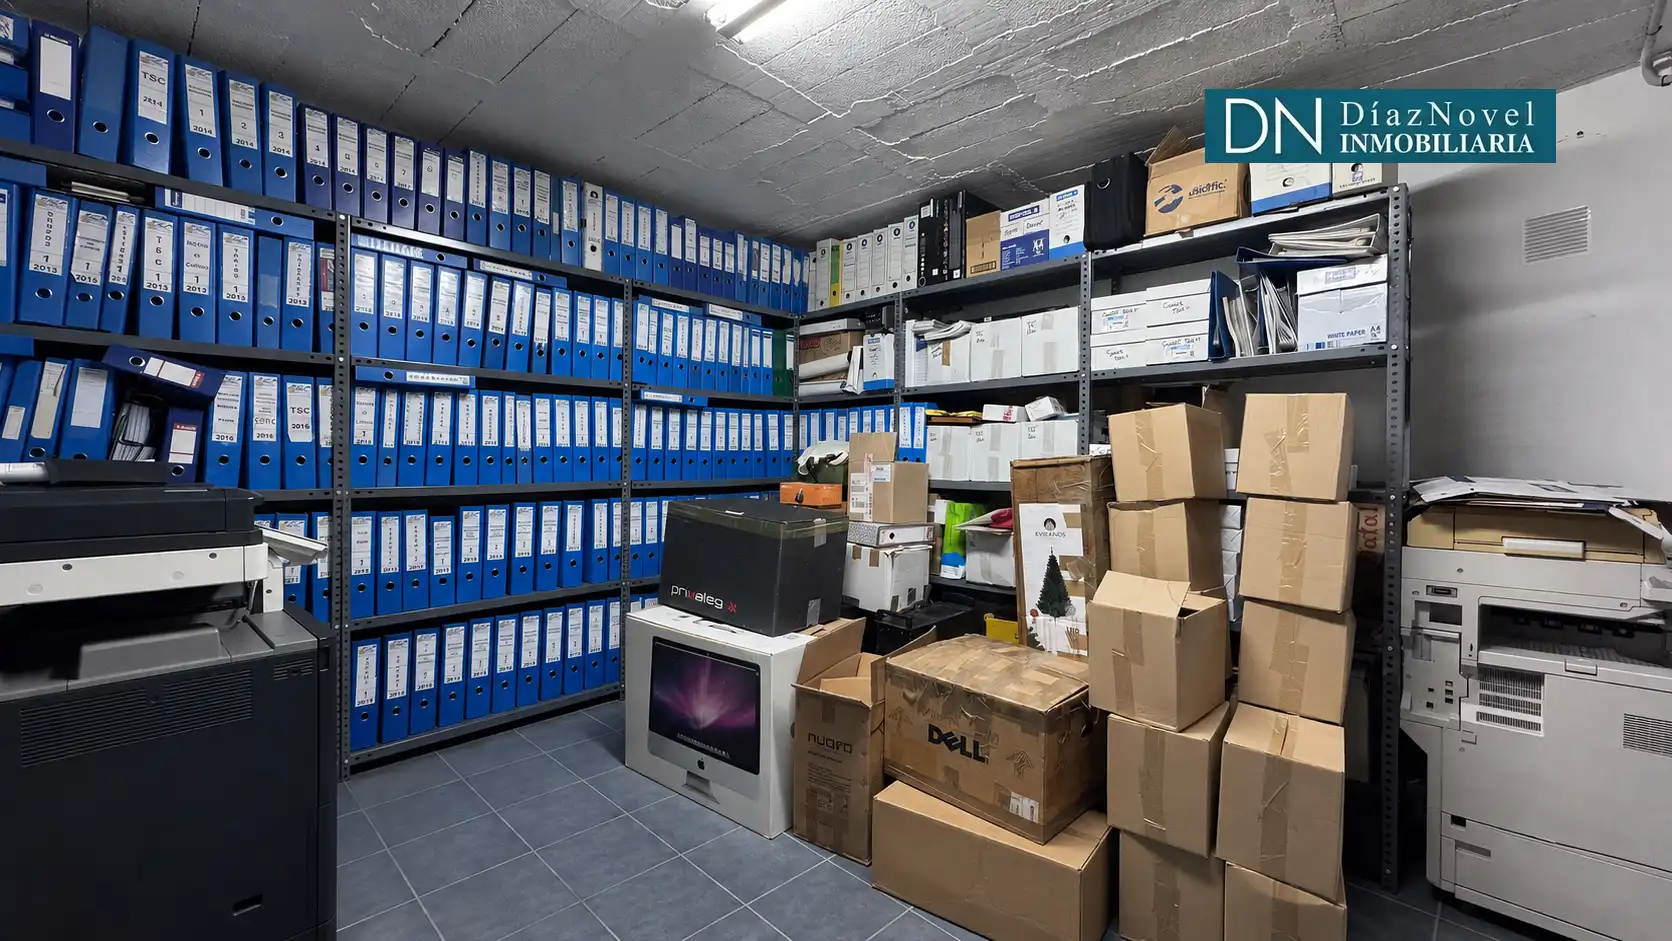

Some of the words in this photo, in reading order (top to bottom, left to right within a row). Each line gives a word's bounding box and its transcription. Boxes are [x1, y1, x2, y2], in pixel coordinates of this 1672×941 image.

[141, 70, 166, 85] TSC
[193, 125, 213, 135] 2014
[236, 138, 254, 147] 2014
[272, 145, 291, 155] 2014
[310, 158, 325, 166] 2014
[33, 264, 57, 273] 2013
[85, 262, 90, 270] 1
[156, 273, 161, 281] 1
[146, 282, 168, 290] 2013
[1327, 331, 1345, 339] WHITE
[290, 406, 310, 414] TSC
[927, 723, 989, 764] DELL
